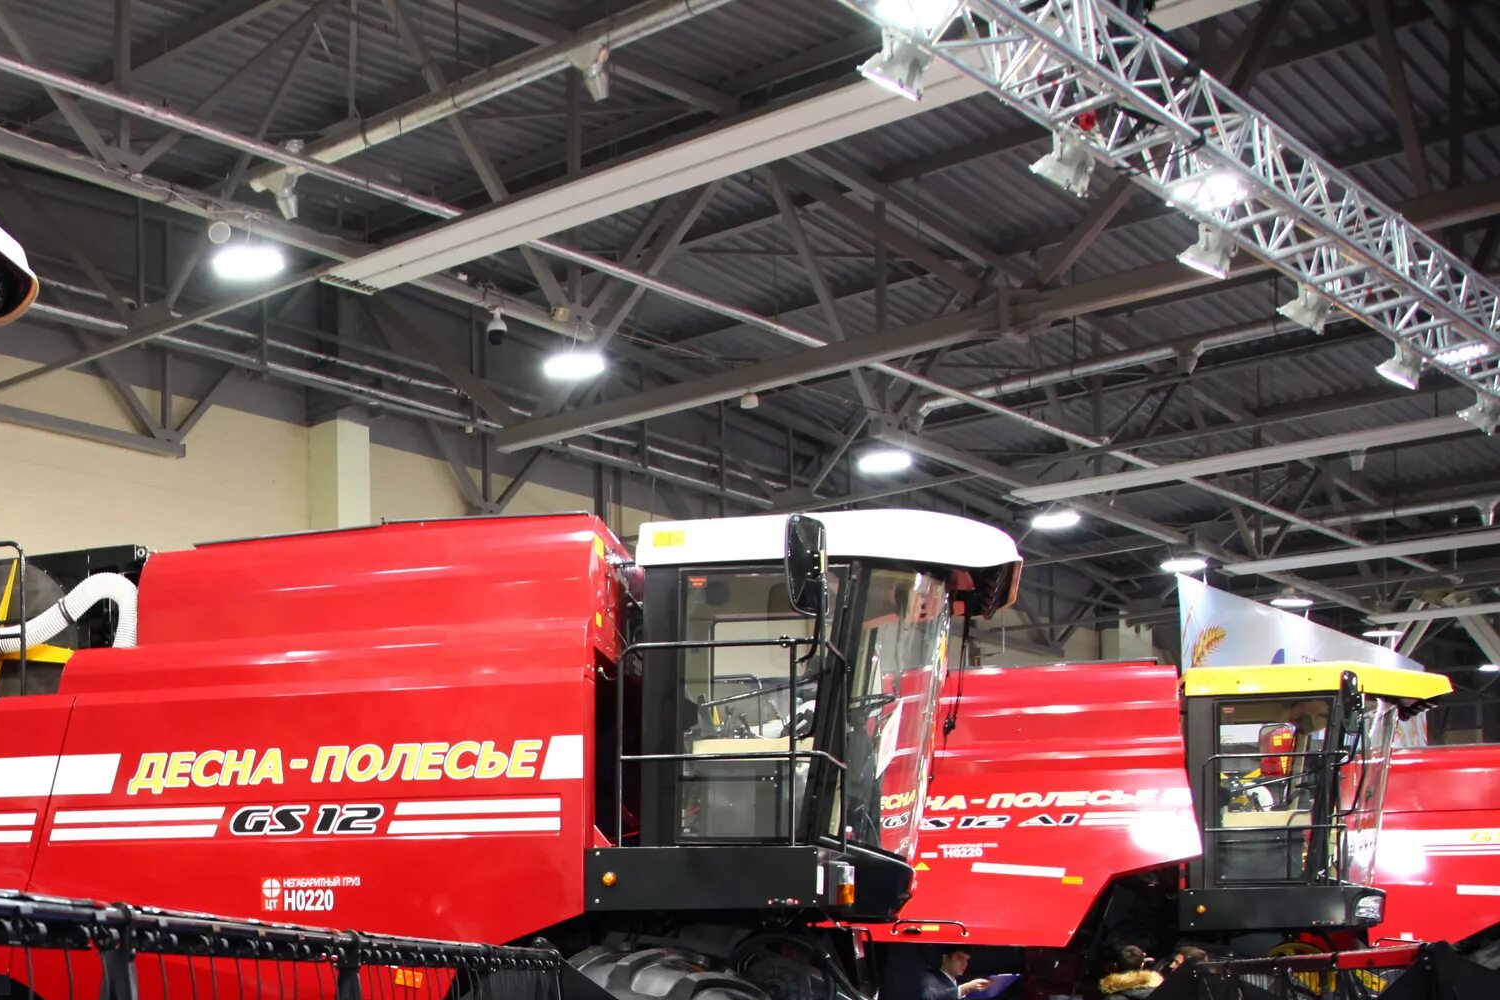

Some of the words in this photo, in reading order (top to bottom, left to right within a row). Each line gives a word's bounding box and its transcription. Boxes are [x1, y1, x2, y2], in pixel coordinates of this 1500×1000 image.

[230, 804, 310, 836] GS
[313, 804, 384, 835] 12
[283, 876, 341, 888] НЕГАБАРИТНЫЙ
[342, 876, 361, 887] ГРУЗ
[264, 899, 278, 911] ЦТ
